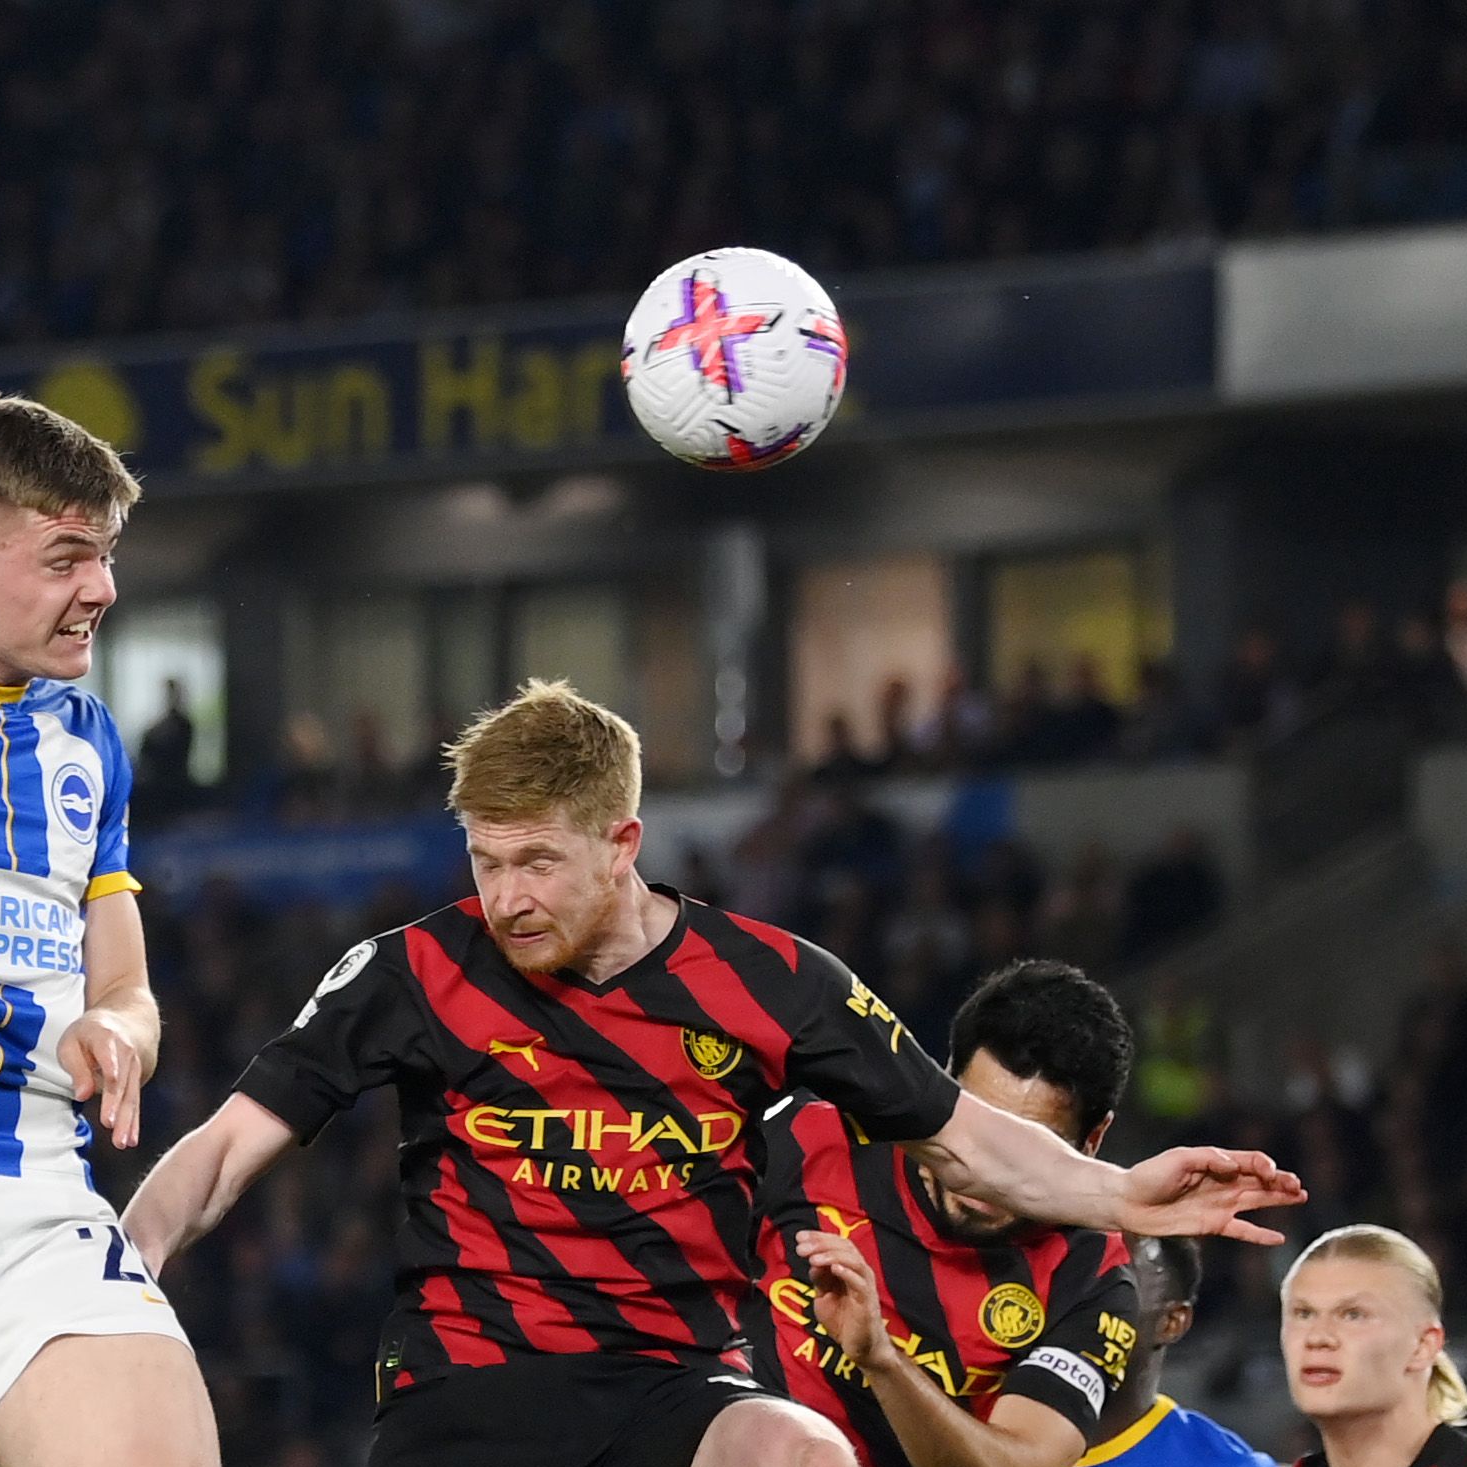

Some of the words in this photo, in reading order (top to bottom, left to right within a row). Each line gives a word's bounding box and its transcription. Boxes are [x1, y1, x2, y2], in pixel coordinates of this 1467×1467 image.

[189, 350, 391, 472] Sun
[465, 1106, 742, 1153] ETIHAD
[512, 1158, 694, 1193] AIRWAYS
[1031, 1348, 1100, 1402] aptain
